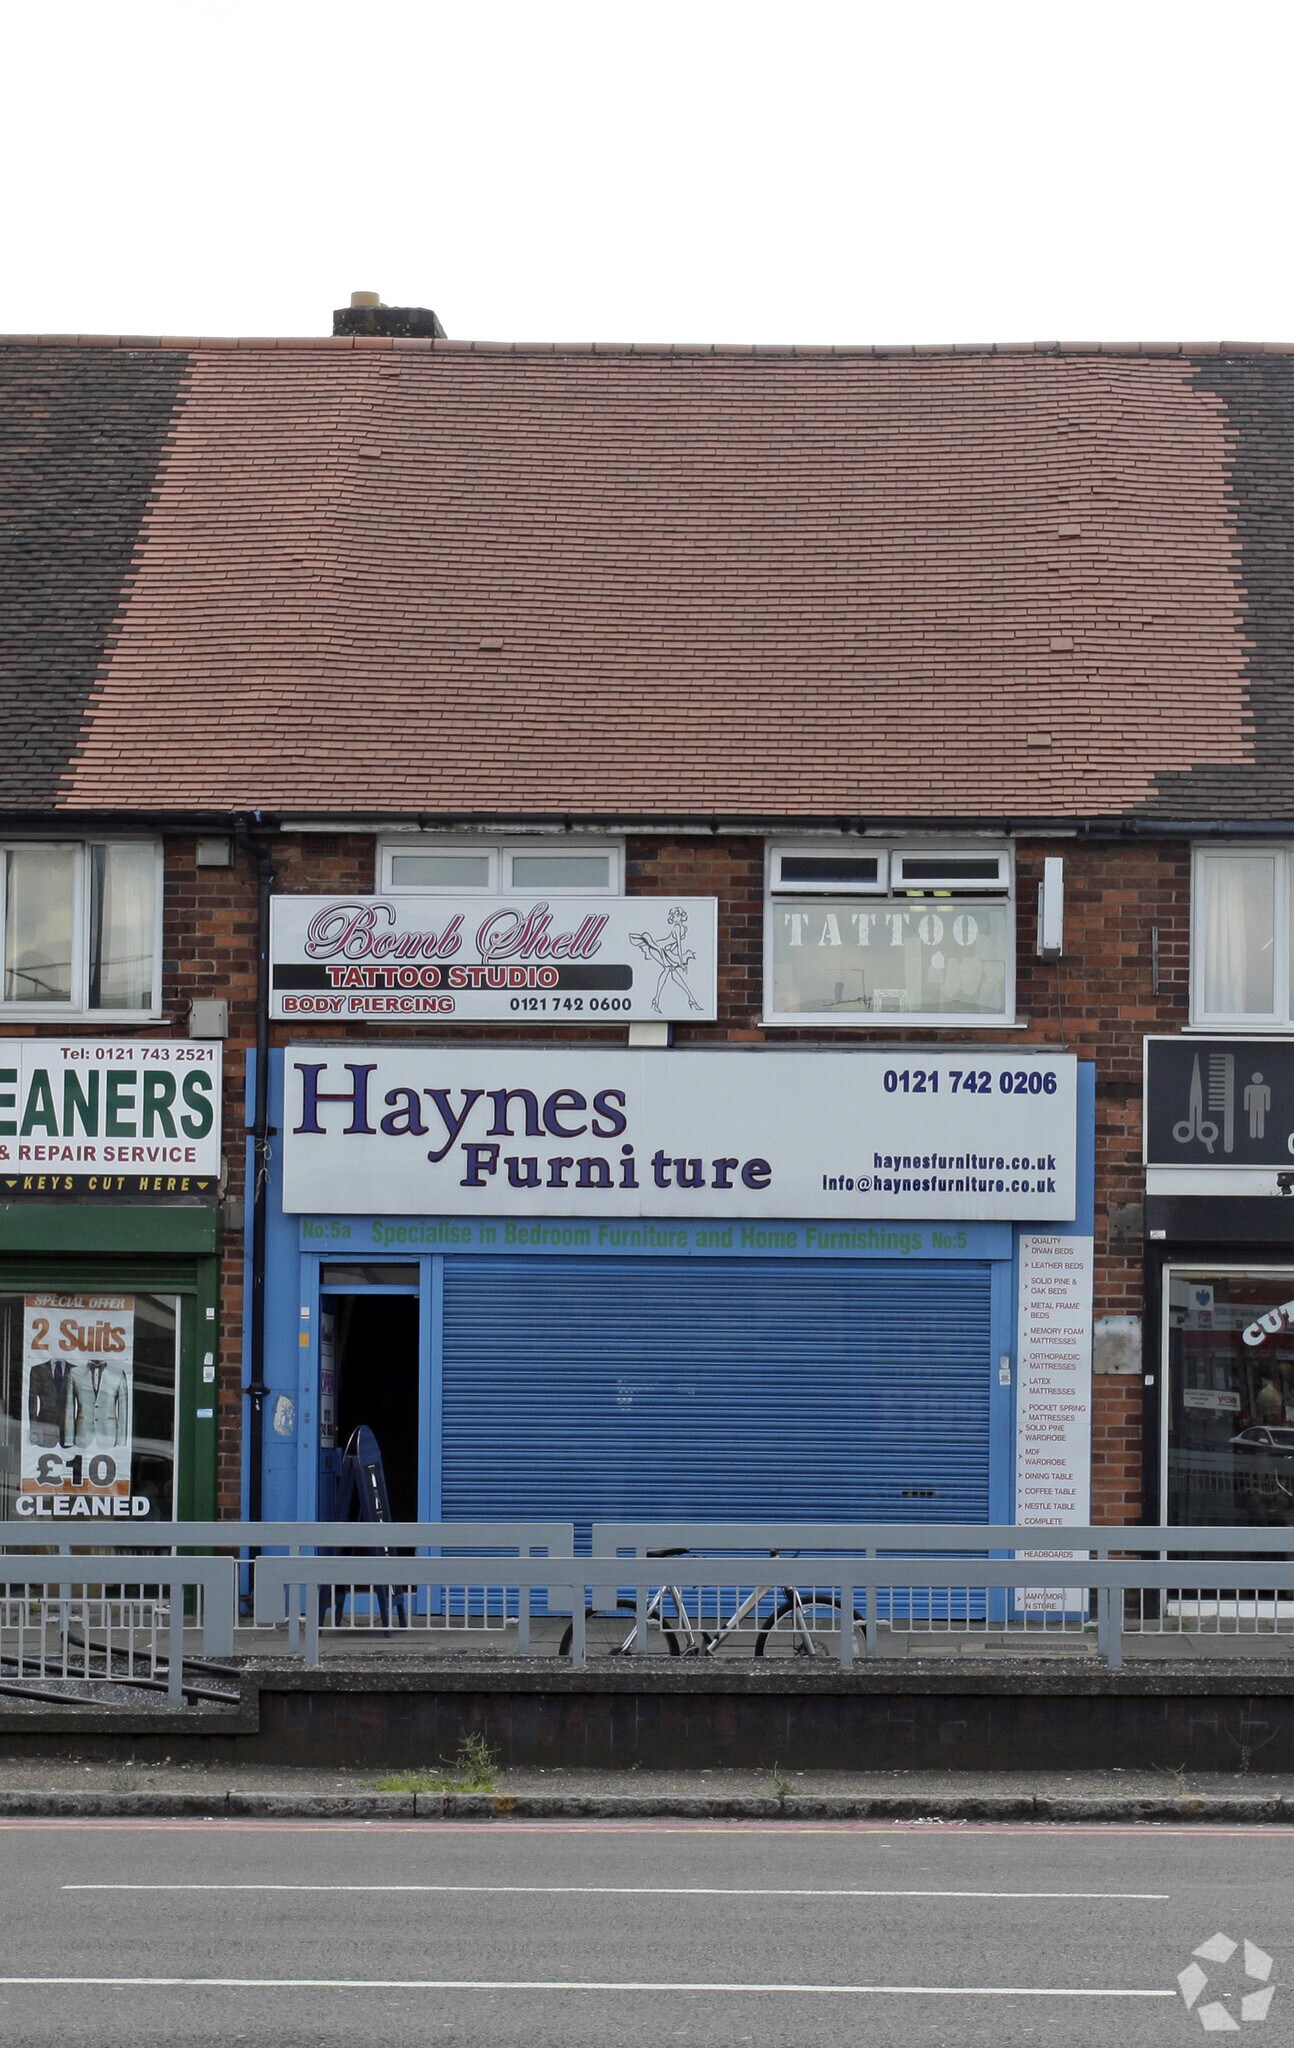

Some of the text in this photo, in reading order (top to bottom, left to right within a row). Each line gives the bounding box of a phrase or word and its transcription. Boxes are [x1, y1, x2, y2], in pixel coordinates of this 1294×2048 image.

[304, 901, 609, 963] Bomb Shell
[784, 913, 978, 946] TATTOO
[326, 966, 560, 988] TATTOO STUDIO
[282, 996, 455, 1013] BODY PIERCING
[509, 998, 632, 1011] 0121 742 0600
[60, 1048, 214, 1061] Tel: 0121 743 2521
[883, 1070, 1057, 1094] 0121 742 0206
[292, 1063, 628, 1163] Haynes
[0, 1145, 197, 1162] & REPAIR SERVICE
[873, 1152, 1056, 1172] haynesfurniture.co.uk
[459, 1143, 772, 1189] Furniture
[23, 1176, 191, 1191] KEYS CUT HERE
[302, 1220, 968, 1255] No:5a Specialise in Bedroom Furniture and Home Furnishings No:5
[1031, 1237, 1062, 1245] QUALITY
[1031, 1277, 1052, 1285] SOLID
[34, 1294, 125, 1309] SPECIAL OFFER
[31, 1318, 127, 1353] 2 Suits
[1030, 1327, 1062, 1335] MEMORY
[1030, 1337, 1077, 1345] MATTRESSES
[1029, 1353, 1080, 1361] ORTHOPAEDIC
[35, 1452, 117, 1488] £10
[15, 1496, 150, 1516] CLEANED
